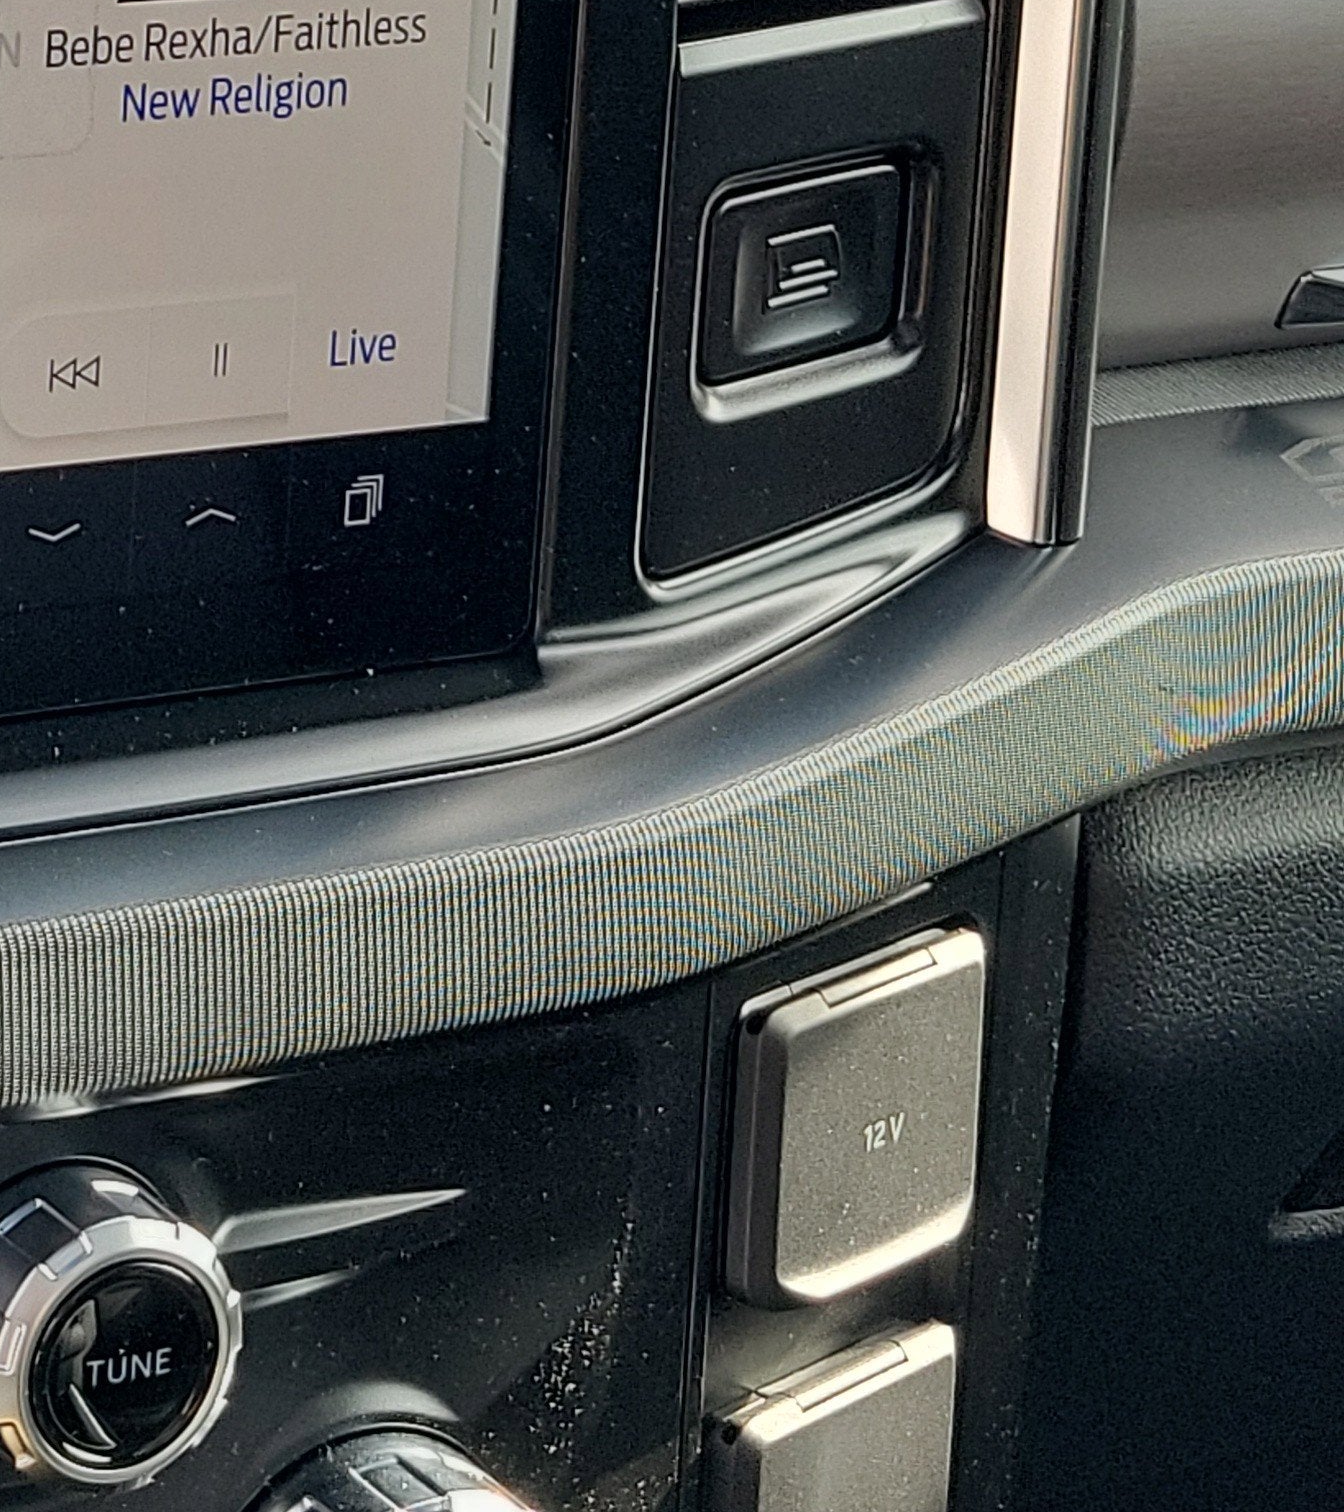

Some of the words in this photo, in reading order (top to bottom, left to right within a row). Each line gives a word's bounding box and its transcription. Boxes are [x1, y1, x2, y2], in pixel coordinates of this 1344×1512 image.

[45, 25, 134, 68] Bebe
[142, 10, 427, 62] Rexha/Faithless
[121, 82, 199, 122] New
[209, 72, 348, 119] Religion
[329, 329, 398, 367] Live
[86, 1348, 173, 1388] TUNE
